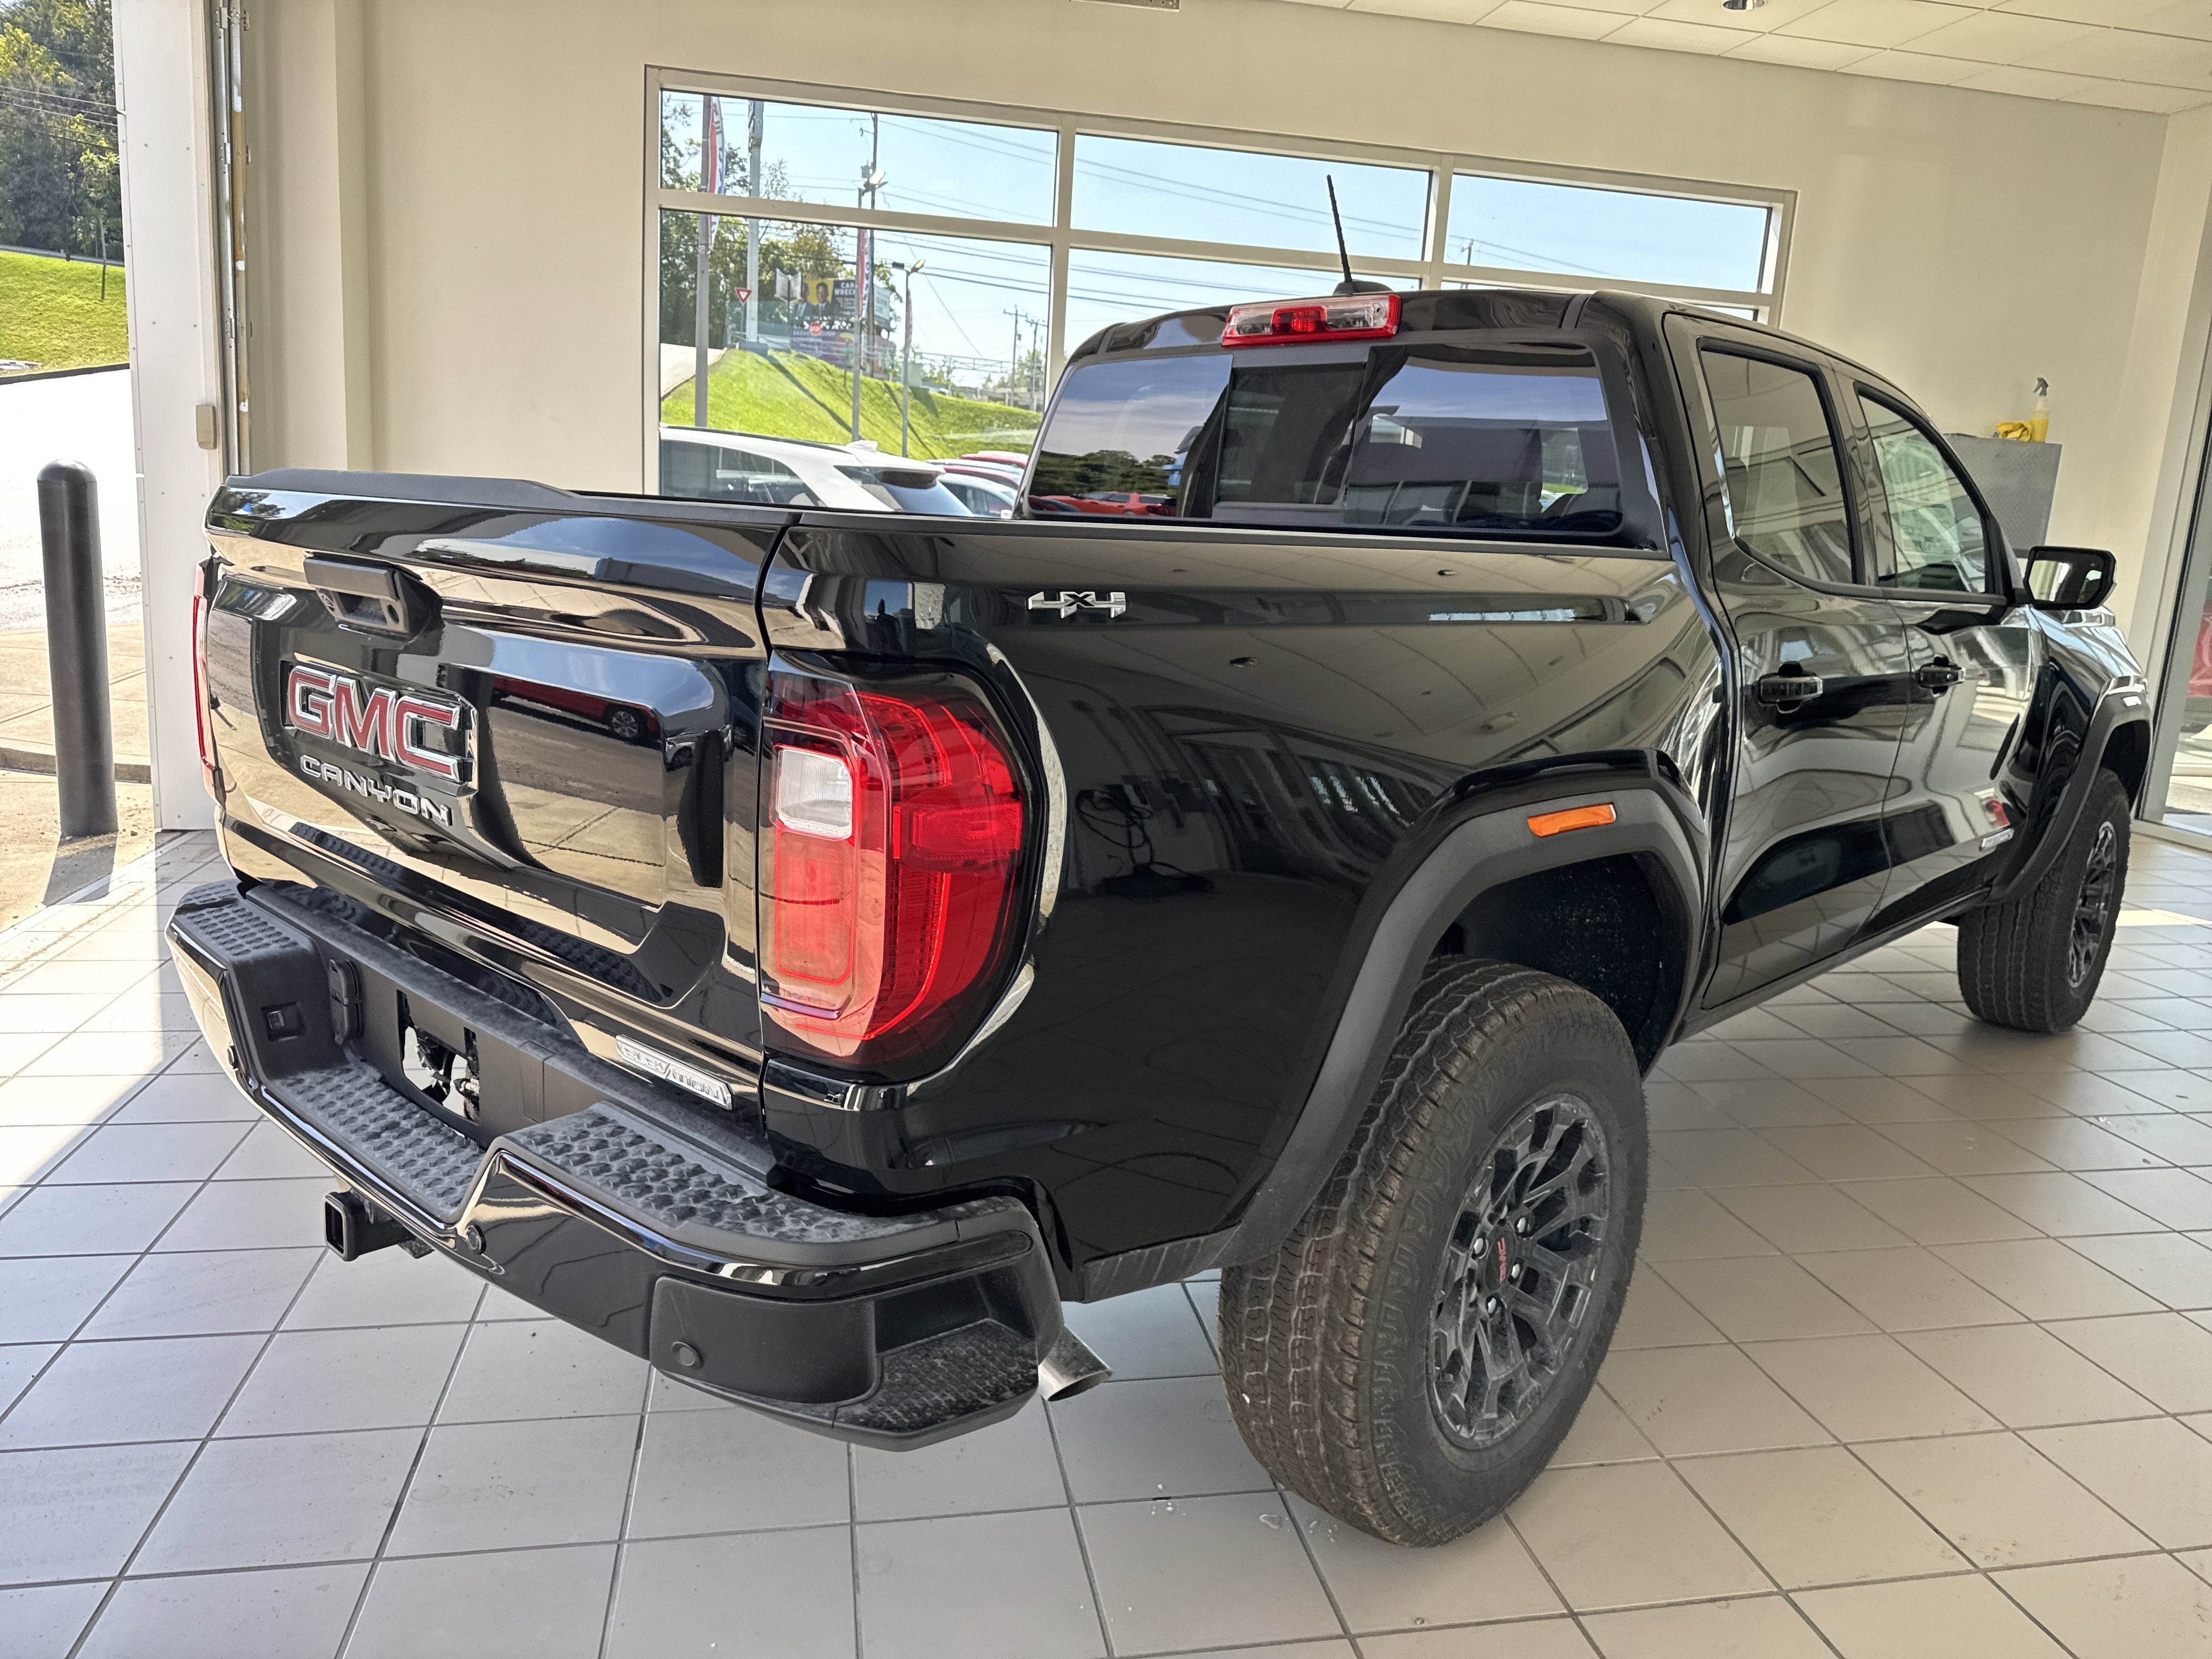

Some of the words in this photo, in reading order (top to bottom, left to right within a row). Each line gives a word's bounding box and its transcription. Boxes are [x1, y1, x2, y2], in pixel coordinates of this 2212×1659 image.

[289, 665, 462, 782] GMC
[300, 754, 453, 826] CANYON
[624, 1046, 719, 1098] ELEVATION
[1497, 1237, 1506, 1283] GMC
